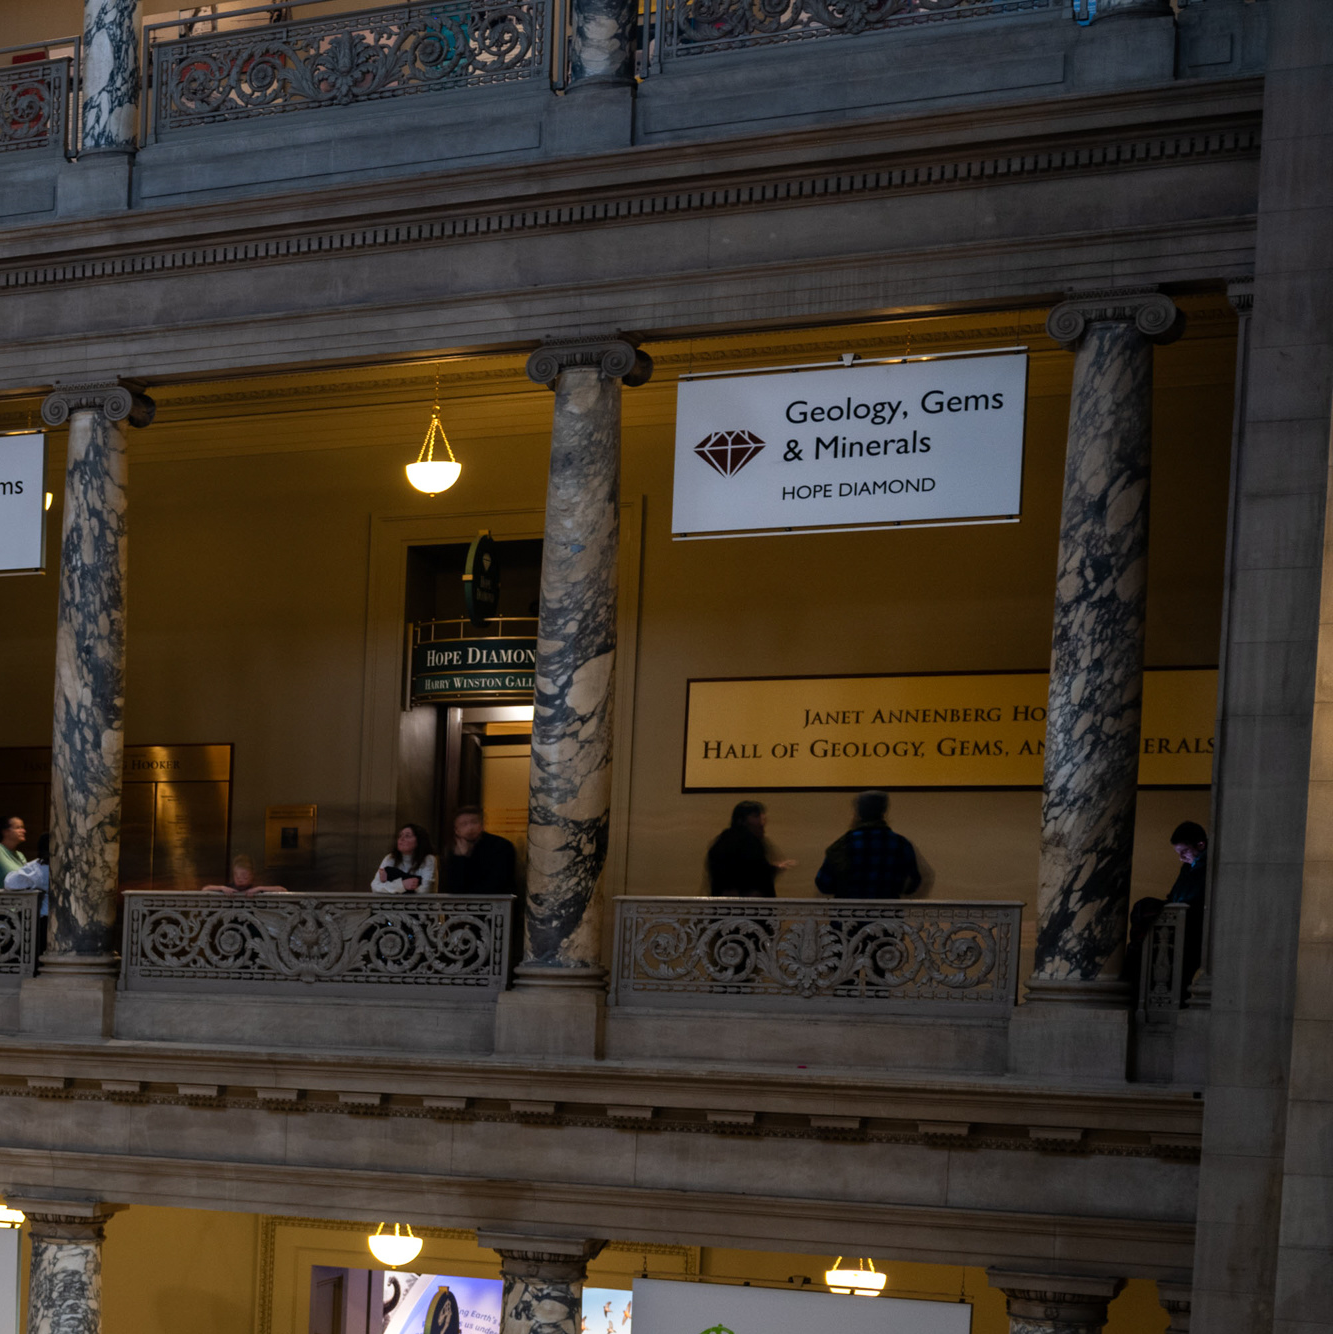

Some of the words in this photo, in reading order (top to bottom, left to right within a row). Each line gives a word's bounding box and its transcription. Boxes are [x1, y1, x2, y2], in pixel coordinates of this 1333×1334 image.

[785, 397, 909, 425] Geology,
[921, 390, 1004, 414] Gems
[783, 439, 803, 462] &
[815, 430, 931, 460] Minerals
[782, 484, 832, 501] HOPE
[839, 478, 936, 497] DIAMOND
[426, 649, 462, 667] HOPE
[424, 679, 450, 690] HARRY
[453, 677, 503, 689] WINSTON
[803, 707, 864, 729] JANET
[872, 706, 1002, 725] ANNENBERG
[702, 739, 762, 760] HALL
[809, 738, 925, 760] GEOLOGY,
[936, 737, 1009, 758] GEMS,
